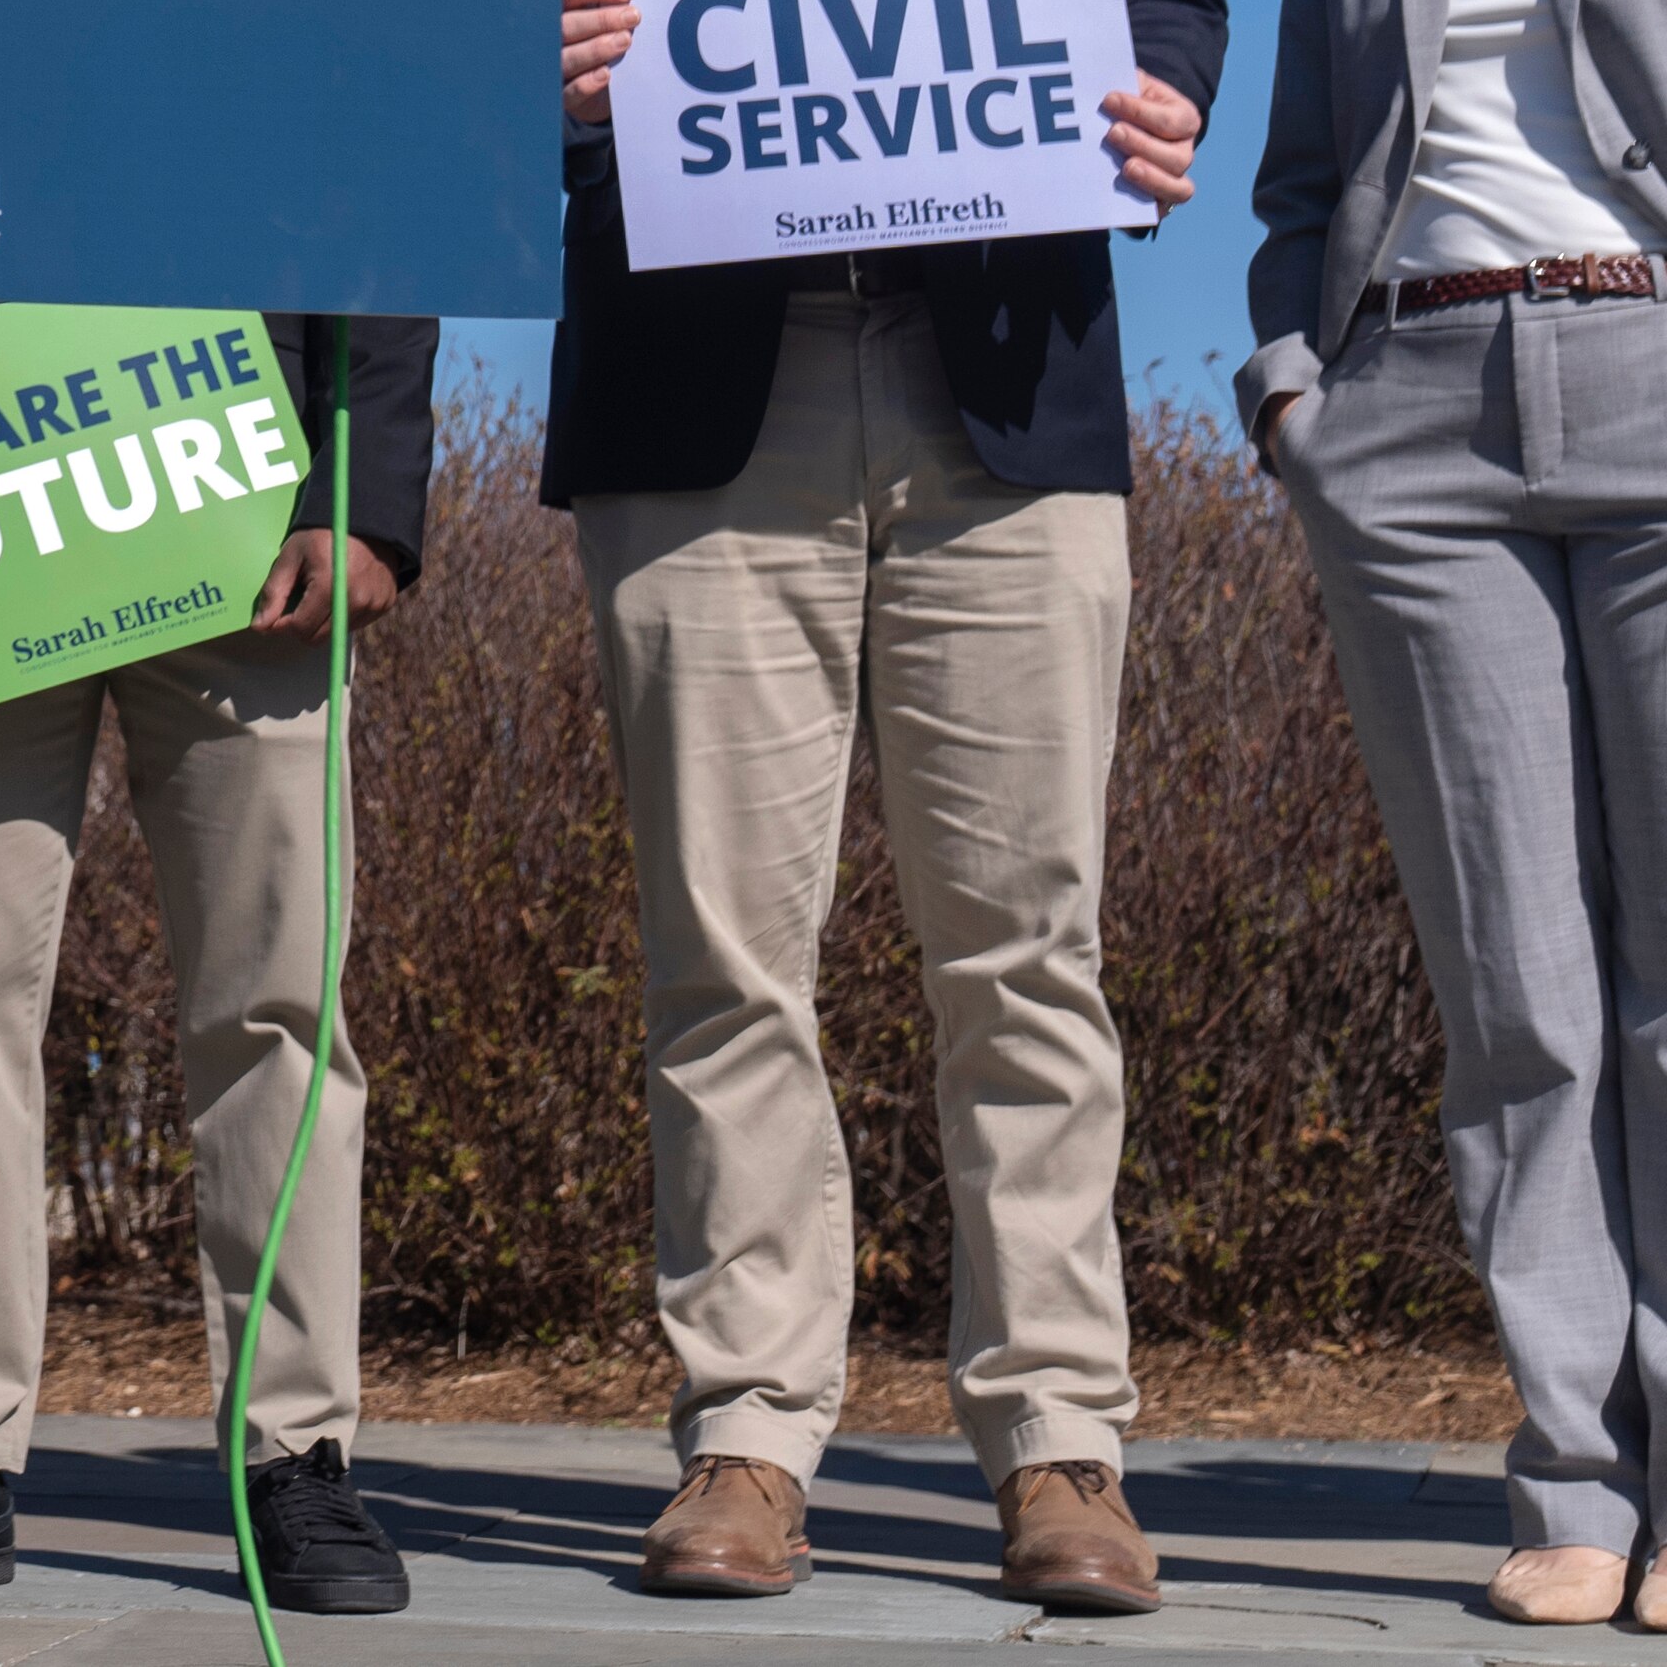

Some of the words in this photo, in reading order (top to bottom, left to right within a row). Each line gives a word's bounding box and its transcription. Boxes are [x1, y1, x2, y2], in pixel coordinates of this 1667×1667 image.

[677, 72, 1081, 177] SERVICE
[775, 204, 877, 239] Sarah
[885, 192, 1006, 228] Elfreth
[117, 327, 261, 410] THE
[11, 615, 107, 664] Sarah
[110, 580, 225, 634] Elfreth
